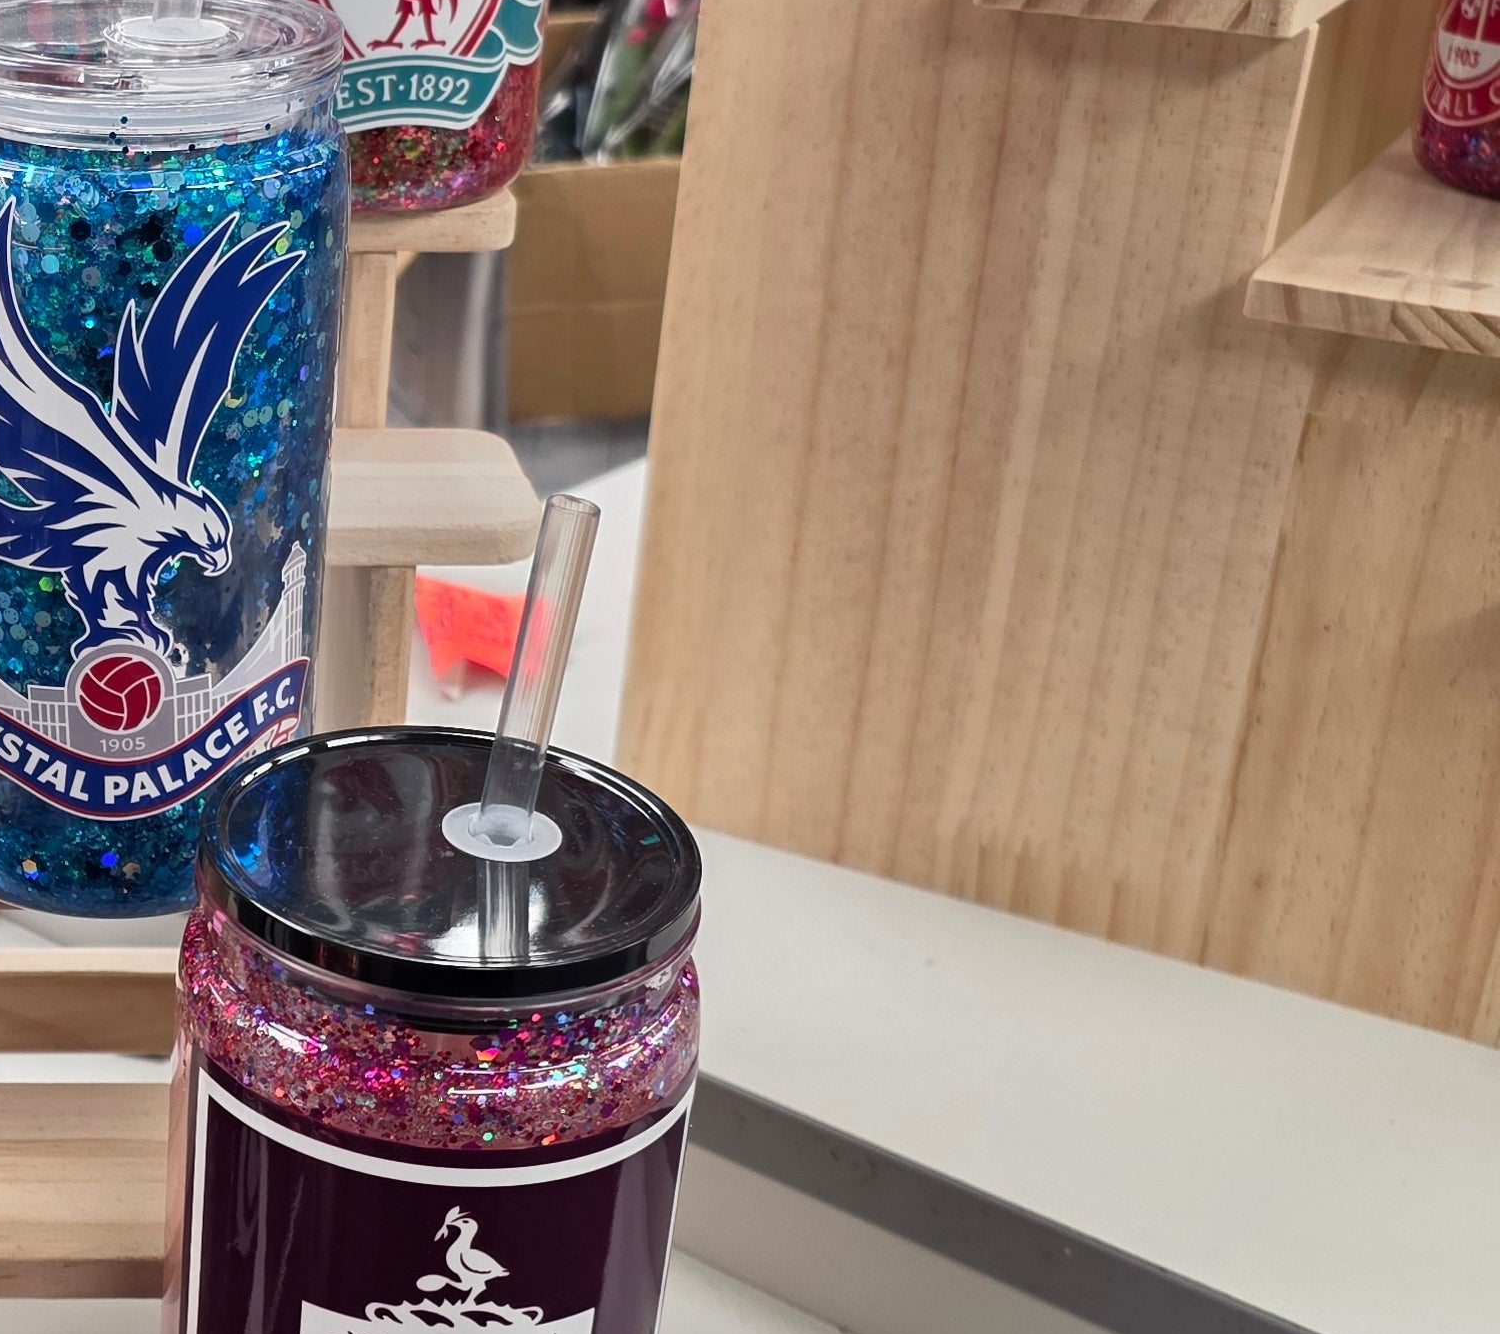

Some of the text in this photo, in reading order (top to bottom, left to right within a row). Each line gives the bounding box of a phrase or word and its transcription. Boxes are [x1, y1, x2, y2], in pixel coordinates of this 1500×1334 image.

[100, 736, 146, 753] 1905
[104, 711, 250, 805] PALACE
[252, 677, 296, 722] F.C.
